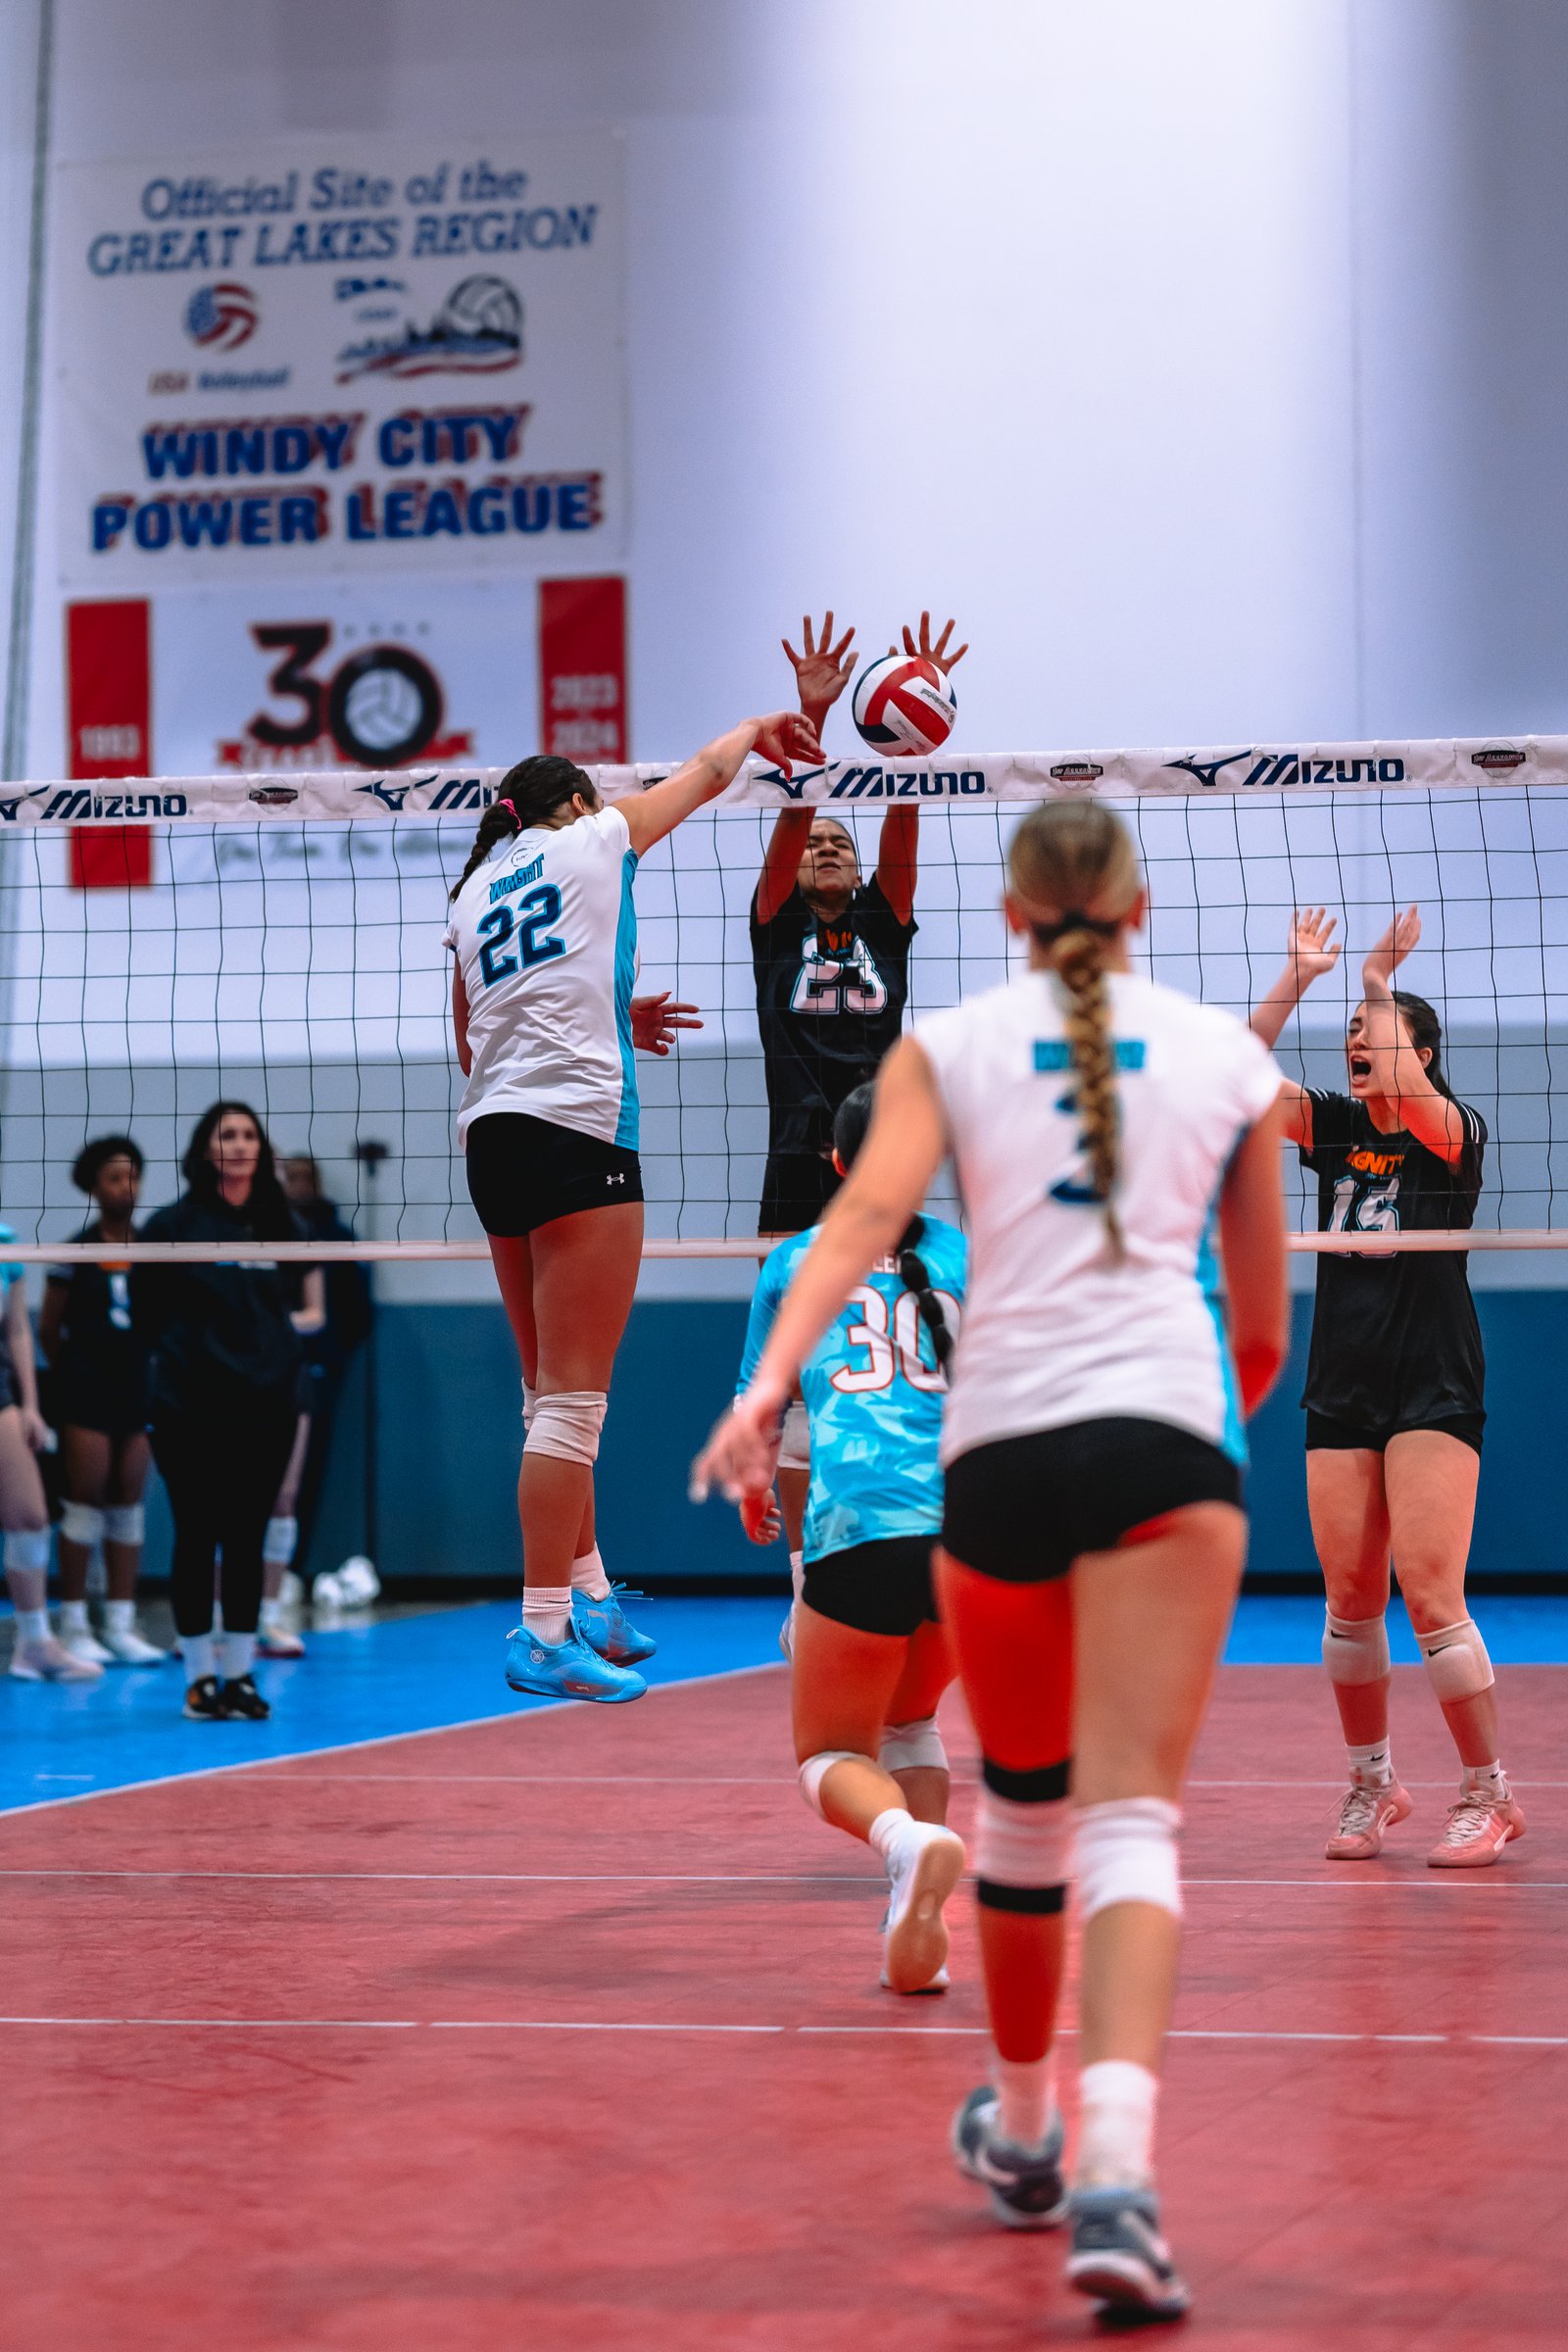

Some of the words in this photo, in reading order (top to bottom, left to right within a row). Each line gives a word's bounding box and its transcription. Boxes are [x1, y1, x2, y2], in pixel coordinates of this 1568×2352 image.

[140, 170, 300, 221] Official
[310, 169, 394, 213] Site
[406, 159, 453, 206] of
[459, 158, 527, 201] the
[86, 225, 242, 278] GREAT
[253, 215, 401, 268] LAKES
[412, 203, 599, 258] REGION
[142, 410, 366, 479] WINDY
[378, 402, 532, 467] CITY
[91, 484, 328, 554] POWER
[345, 470, 603, 541] LEAGUE
[245, 621, 444, 768] 30
[40, 788, 187, 819] MIZUNO
[829, 765, 986, 799] MIZUNO
[1242, 753, 1404, 786] MIZUNO
[476, 883, 566, 989] 22
[789, 933, 888, 1014] 23
[829, 1284, 962, 1395] 30
